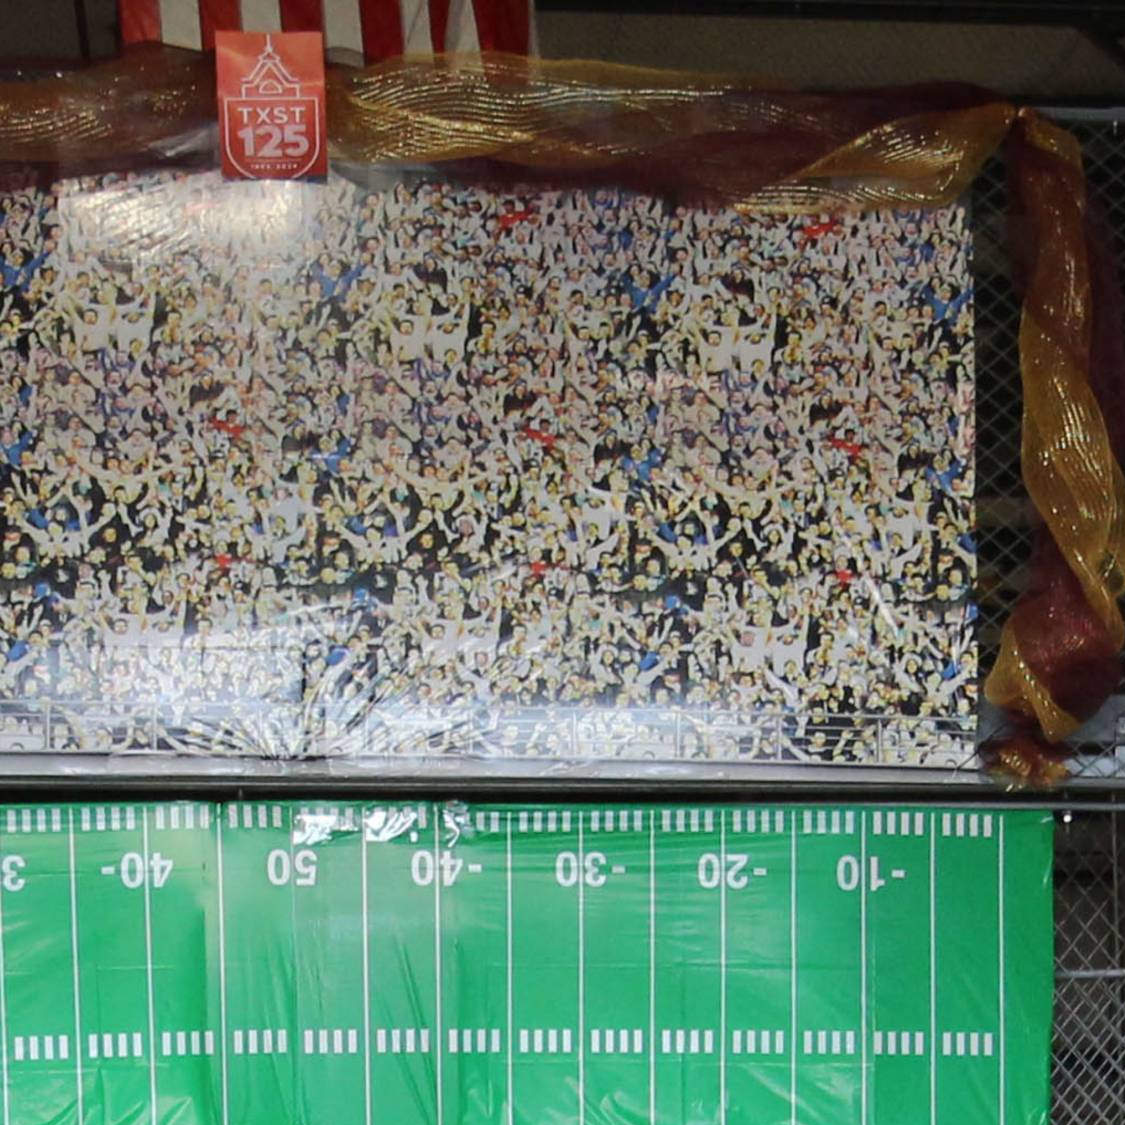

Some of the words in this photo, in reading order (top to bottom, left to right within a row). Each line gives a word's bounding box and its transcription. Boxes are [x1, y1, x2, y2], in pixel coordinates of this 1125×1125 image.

[237, 106, 305, 124] TXST
[237, 125, 309, 157] 125
[267, 849, 317, 887] 50
